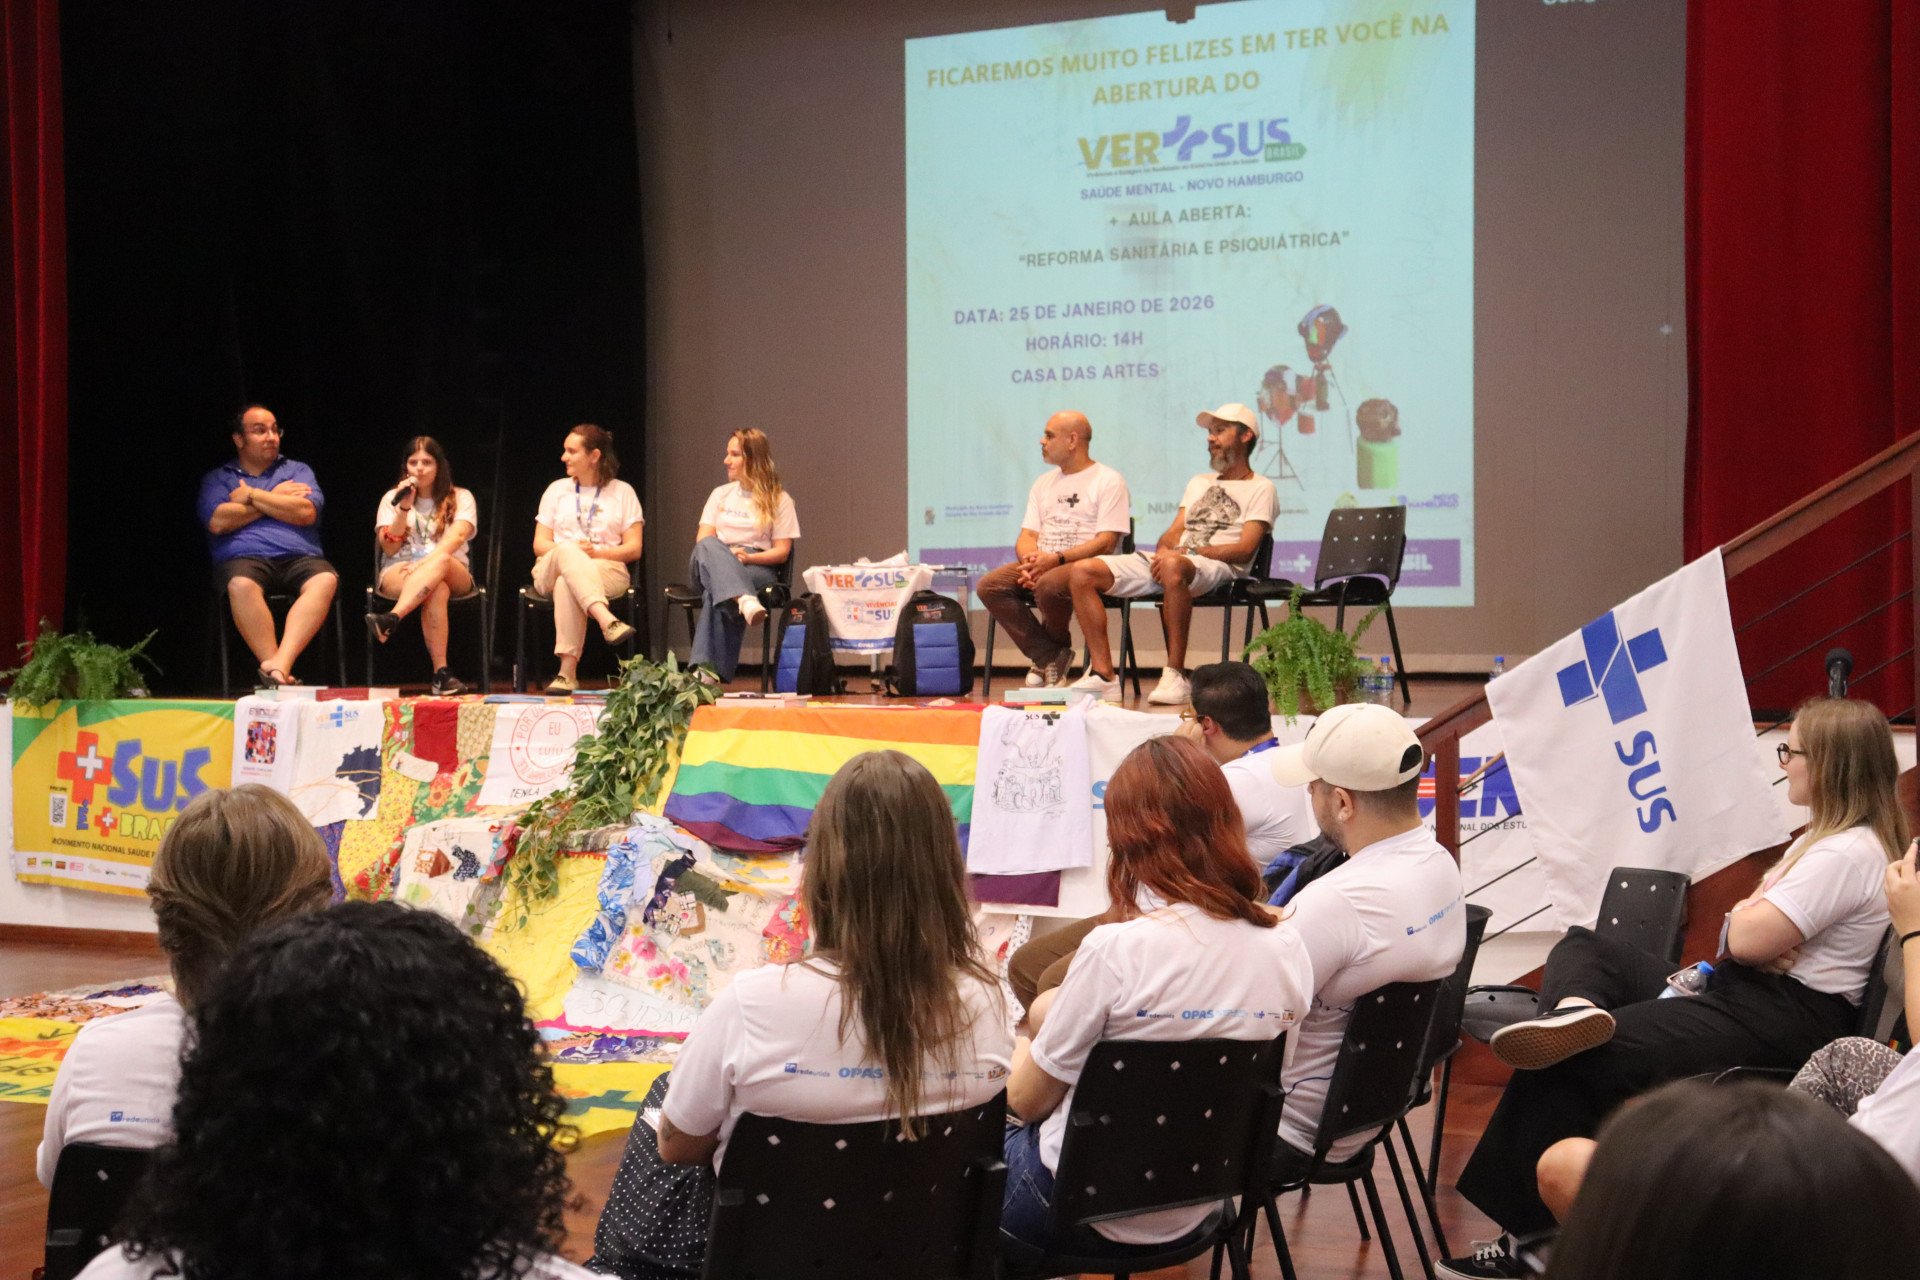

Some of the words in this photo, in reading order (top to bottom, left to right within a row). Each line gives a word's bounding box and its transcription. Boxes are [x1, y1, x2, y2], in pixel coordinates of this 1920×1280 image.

[927, 57, 1054, 89] FICAREMOS
[1061, 48, 1139, 75] MUITO
[1146, 37, 1233, 66] FELIZES
[1241, 33, 1276, 56] EM
[1285, 27, 1328, 50] TER
[1336, 13, 1402, 43] VOCÊ
[1411, 14, 1449, 37] NA
[1092, 76, 1217, 106] ABERTURA
[1224, 70, 1261, 93] DO
[1077, 131, 1161, 170] VER
[1211, 117, 1292, 159] SUS
[1080, 183, 1123, 200] SAÚDE
[1126, 181, 1176, 197] MENTAL
[1187, 175, 1225, 192] NOVO
[1227, 170, 1305, 188] HAMBURGO
[1128, 210, 1173, 227] AULA
[1178, 204, 1252, 224] ABERTA:
[1109, 240, 1199, 262] SANITÁRIA
[1204, 240, 1214, 255] E
[954, 308, 1004, 325] DATA:
[1009, 306, 1030, 321] 25
[1035, 304, 1057, 320] DE
[1061, 299, 1136, 318] JANEIRO
[1141, 298, 1164, 314] DE
[1169, 294, 1215, 312] 2026
[1026, 331, 1107, 352] HORÁRIO:
[1113, 331, 1144, 347] 14H
[1011, 367, 1057, 384] CASA
[1062, 365, 1097, 381] DAS
[1102, 362, 1160, 379] ARTES
[1147, 502, 1181, 515] NUM
[823, 573, 856, 589] VER
[873, 570, 905, 587] SUS
[107, 738, 212, 814] SUS
[1614, 730, 1678, 834] SUS
[120, 812, 175, 841] BRA
[91, 841, 126, 856] NACIONAL
[1181, 1009, 1215, 1020] OPAS
[838, 1066, 884, 1080] OPAS
